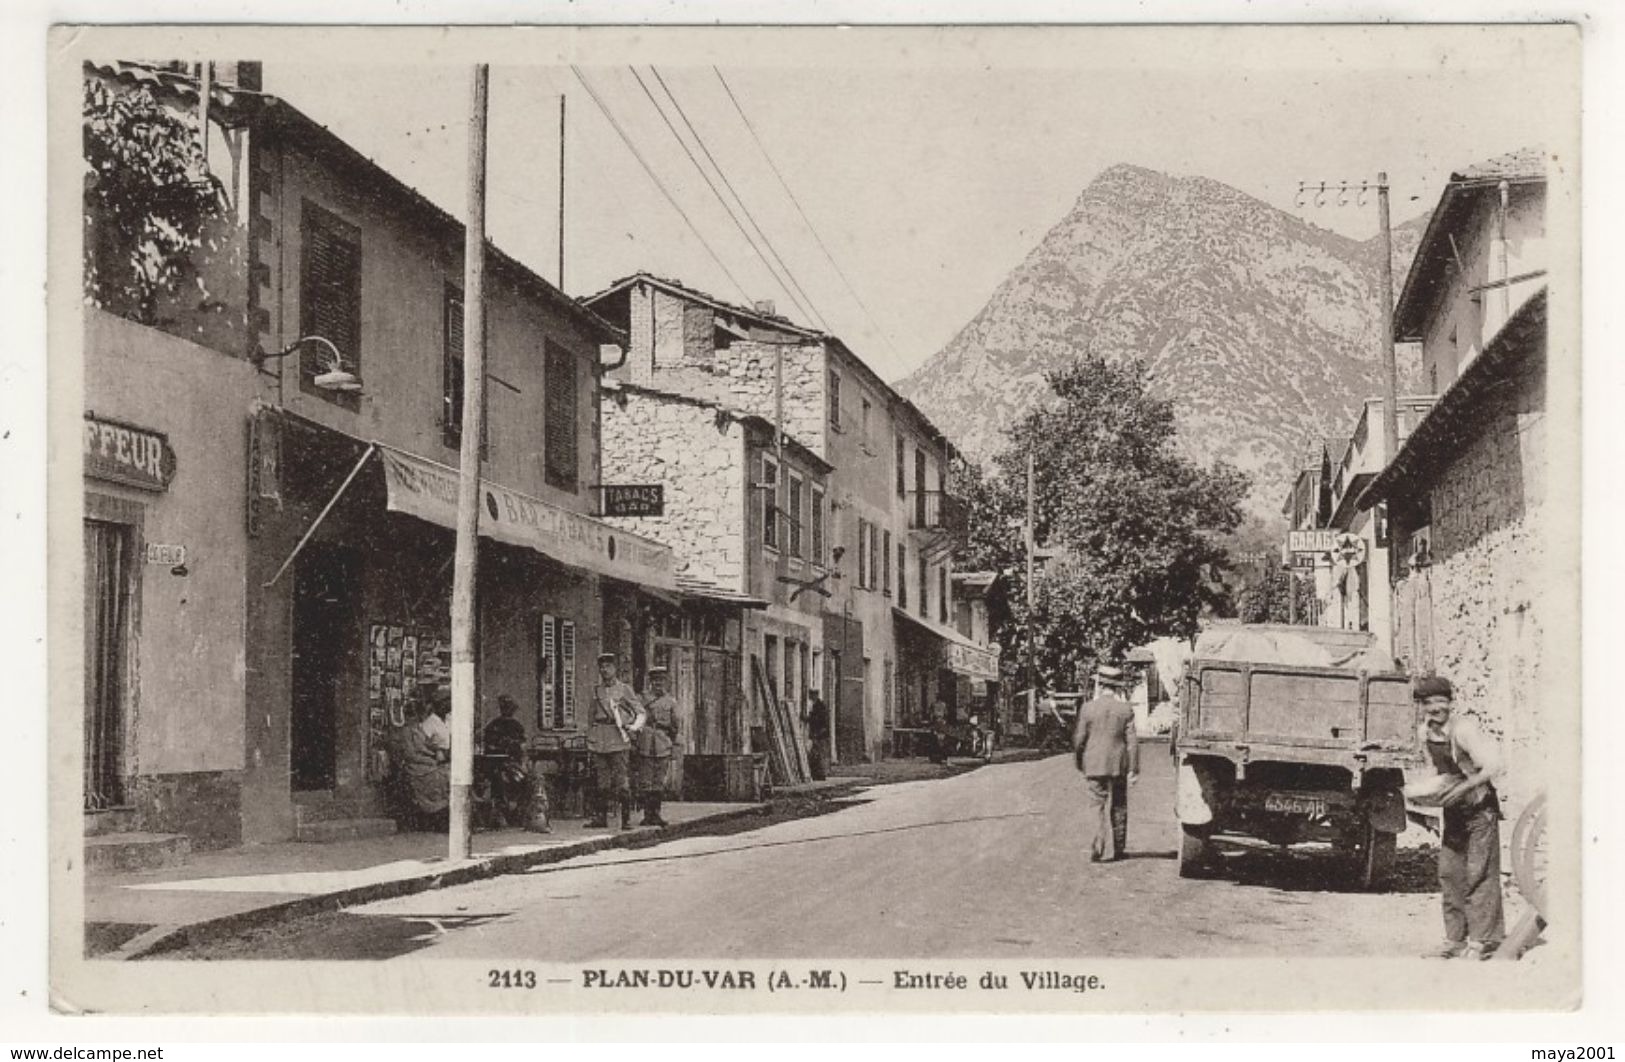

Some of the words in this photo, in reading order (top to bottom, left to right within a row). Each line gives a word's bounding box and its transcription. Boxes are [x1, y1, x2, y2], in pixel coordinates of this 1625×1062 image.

[607, 487, 658, 504] TABACS
[488, 970, 537, 988] 2113
[582, 970, 756, 989] PLAN-DU-VAR
[768, 971, 847, 992] (A.-M.)
[894, 971, 967, 989] Entrée
[979, 971, 1007, 990] du
[1020, 971, 1105, 993] Village.
